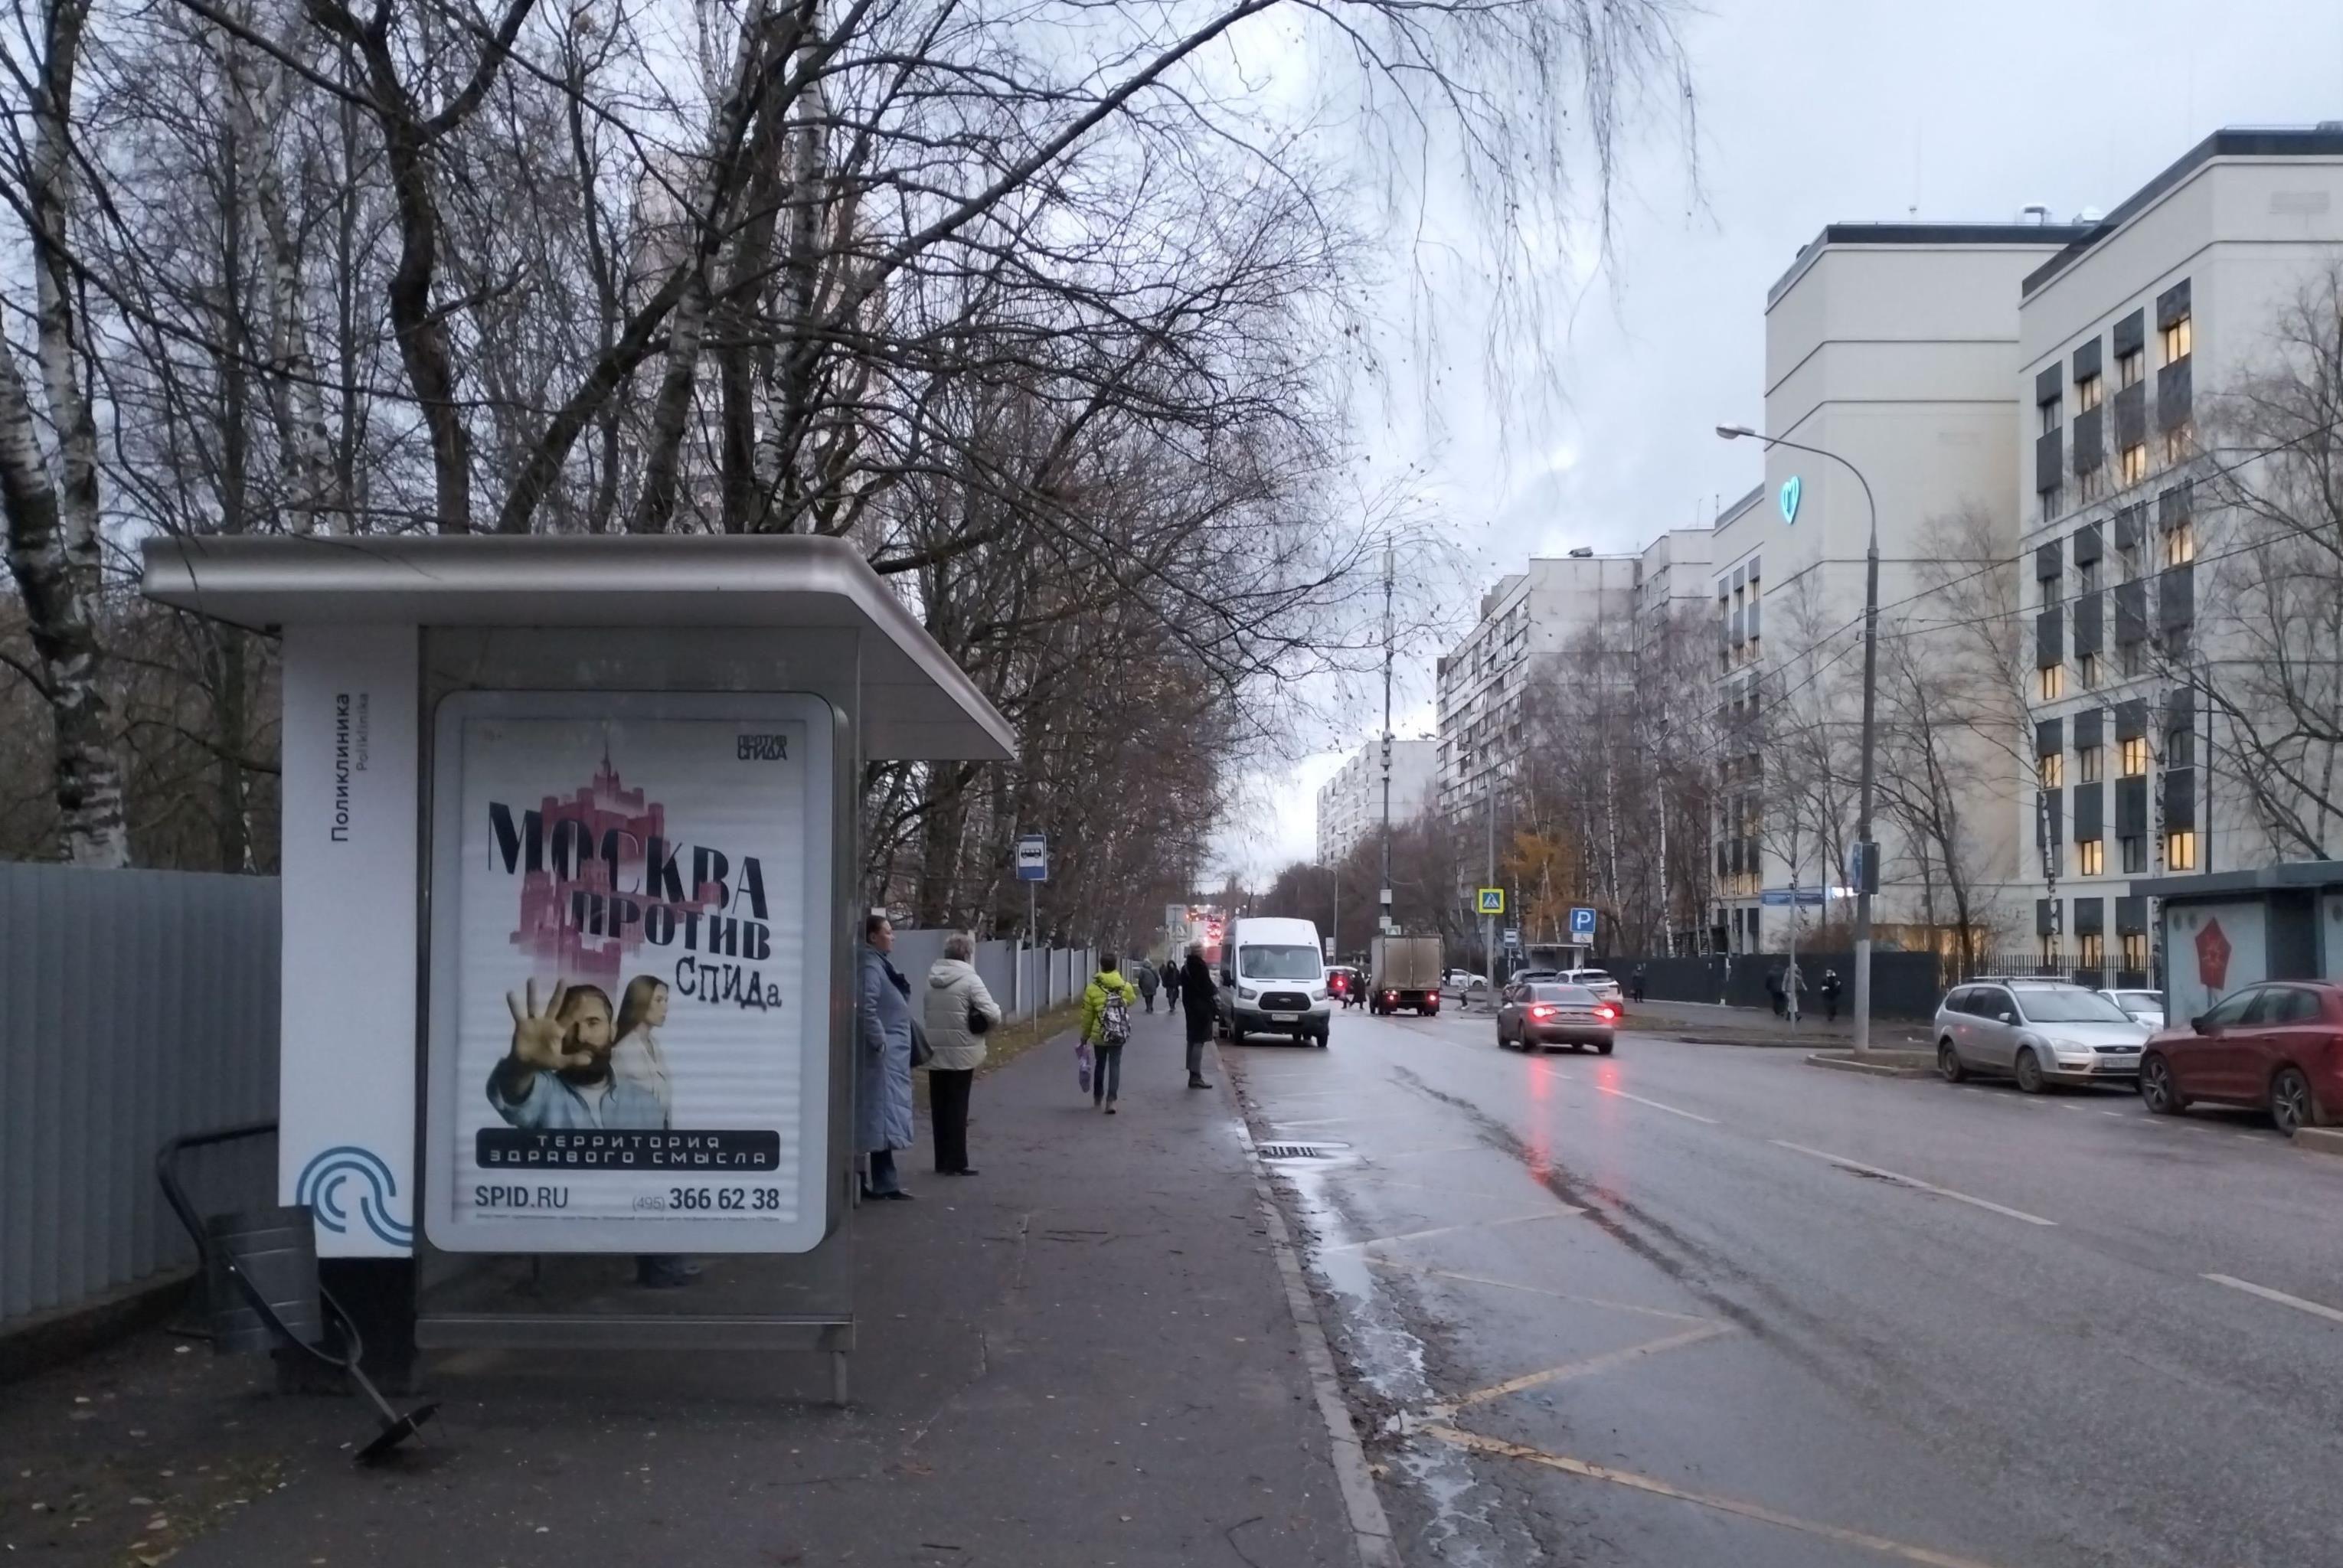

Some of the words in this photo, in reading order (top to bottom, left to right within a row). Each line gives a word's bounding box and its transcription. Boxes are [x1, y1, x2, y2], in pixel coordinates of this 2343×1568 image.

[356, 694, 368, 771] Poliklinika
[737, 735, 787, 747] ПРОТИВ
[737, 746, 787, 760] СПИДА
[332, 694, 349, 841] Поликлиника
[488, 801, 769, 920] МОСКВА
[571, 890, 770, 961] ПРОТИВ
[1577, 911, 1591, 929] P
[675, 956, 782, 1011] СПИДа
[537, 1135, 720, 1149] ТЕРРИТОРИЯ
[489, 1150, 635, 1164] ЗДРАВОГО
[652, 1152, 766, 1165] СМЫСЛА
[475, 1185, 568, 1208] SPID.RU
[632, 1195, 665, 1212] (495)
[668, 1187, 712, 1210] 366
[717, 1188, 746, 1210] 62
[751, 1188, 780, 1210] 38
